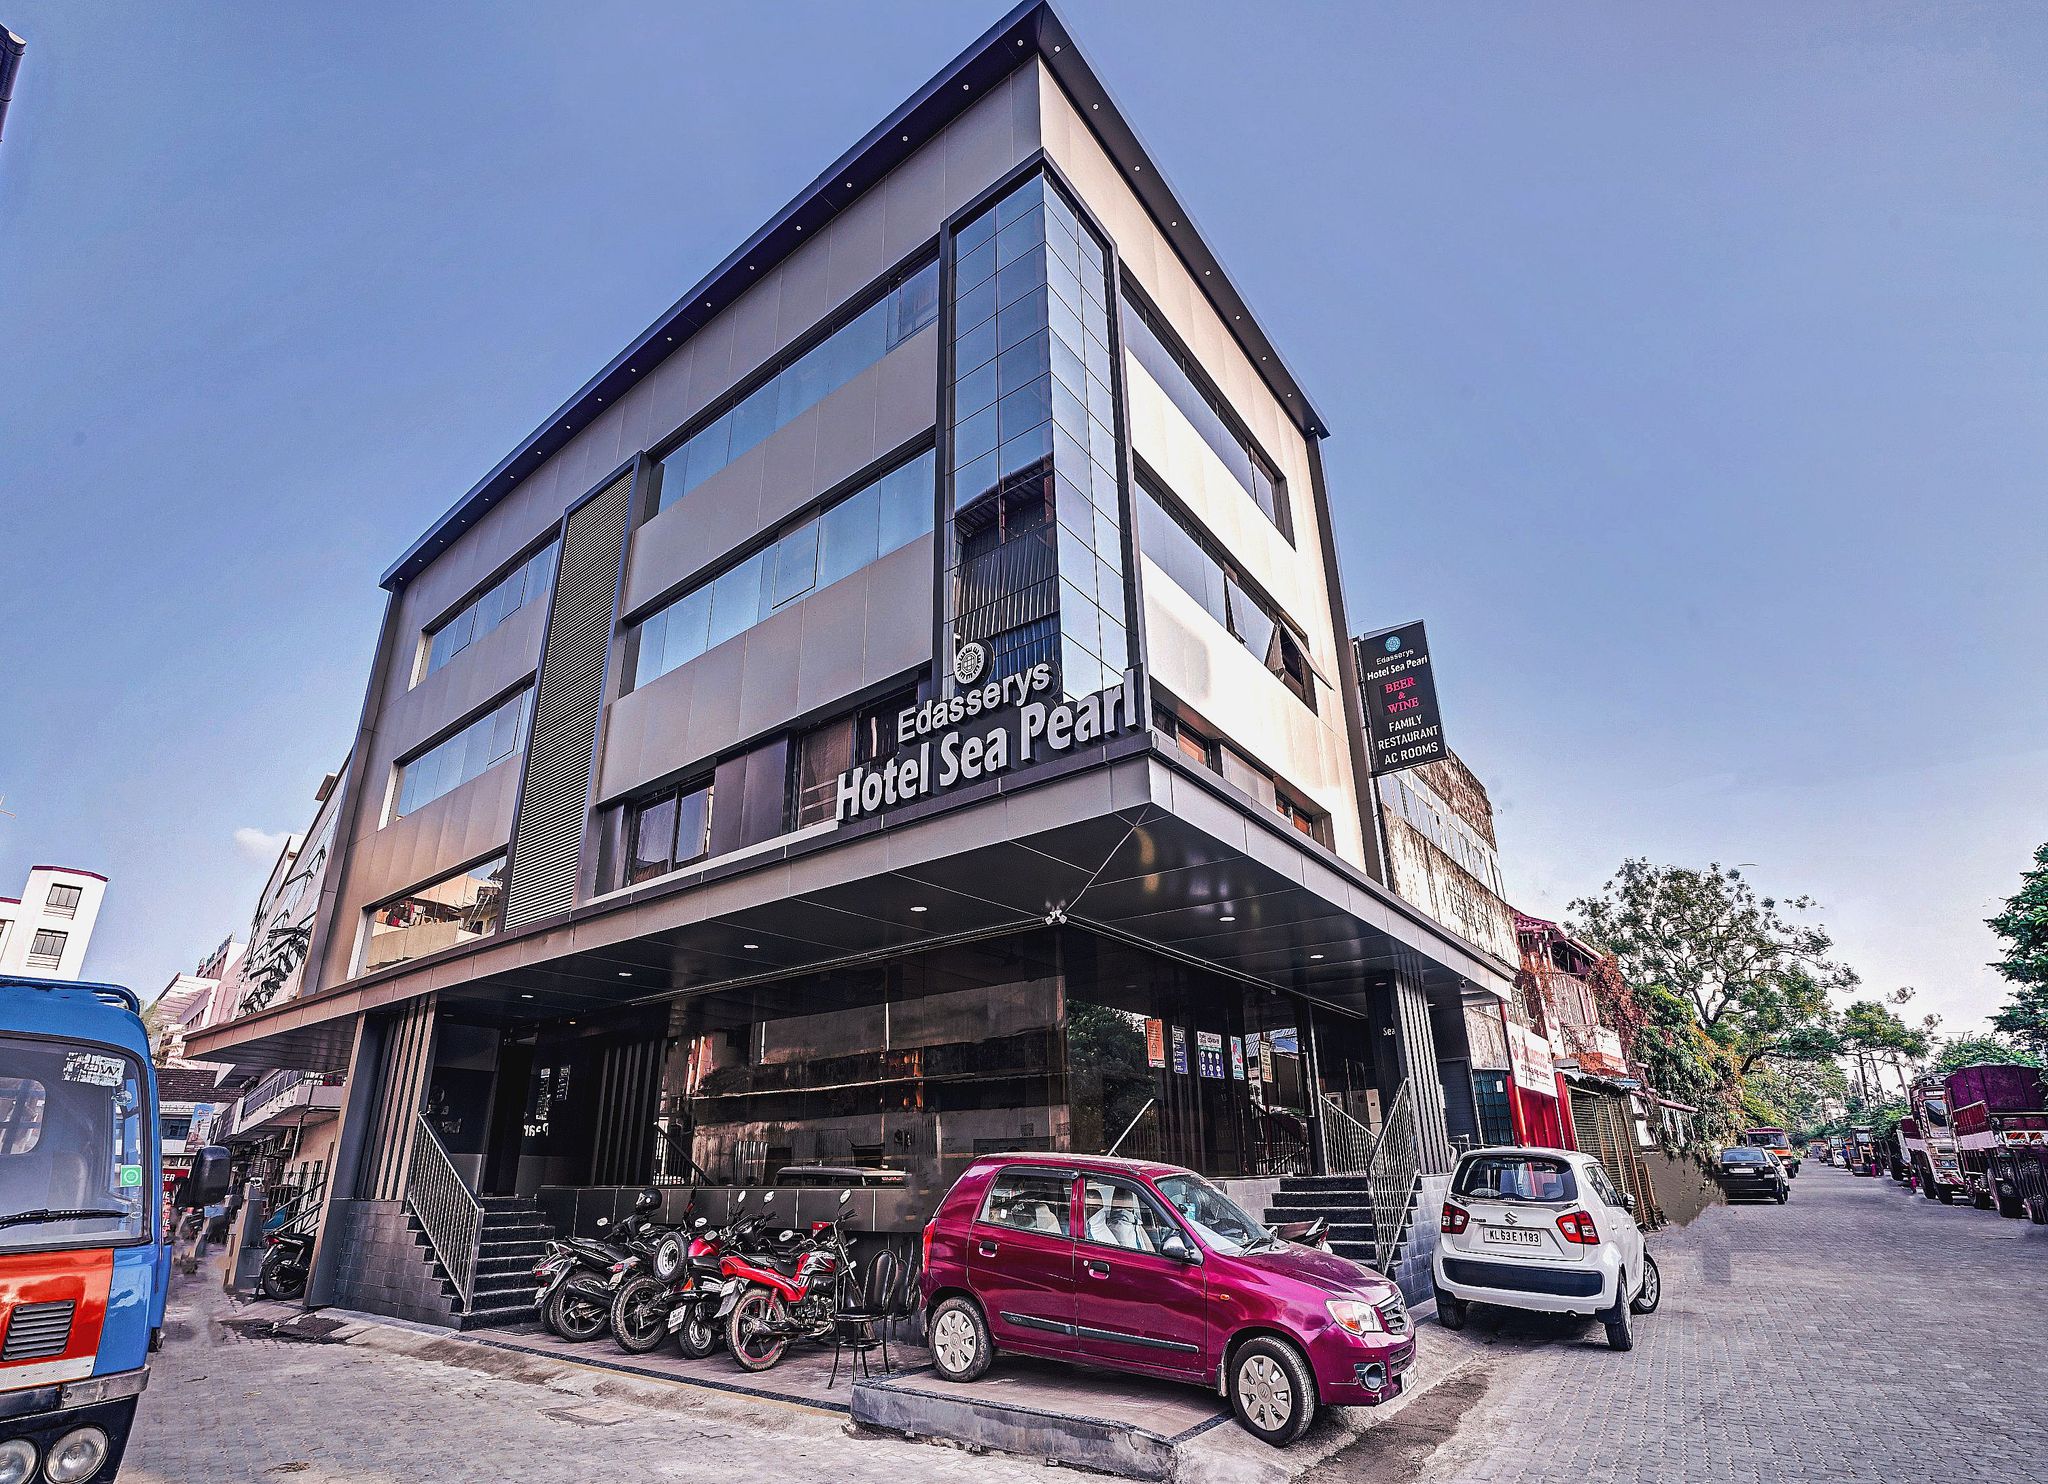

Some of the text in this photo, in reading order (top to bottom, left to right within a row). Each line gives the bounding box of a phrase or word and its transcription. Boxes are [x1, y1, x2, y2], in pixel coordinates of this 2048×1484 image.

[1367, 655, 1428, 681] Hotel Sea Pearl
[1376, 648, 1414, 665] Edasserys
[1385, 676, 1416, 694] BEER
[898, 662, 1052, 743] Edasserys
[1387, 697, 1420, 714] WINE
[1388, 714, 1423, 732] FAMILY
[836, 668, 1137, 821] Hotel Sea Pearl
[1377, 725, 1439, 751] RESTAURANT
[1384, 741, 1439, 765] AC ROOMS
